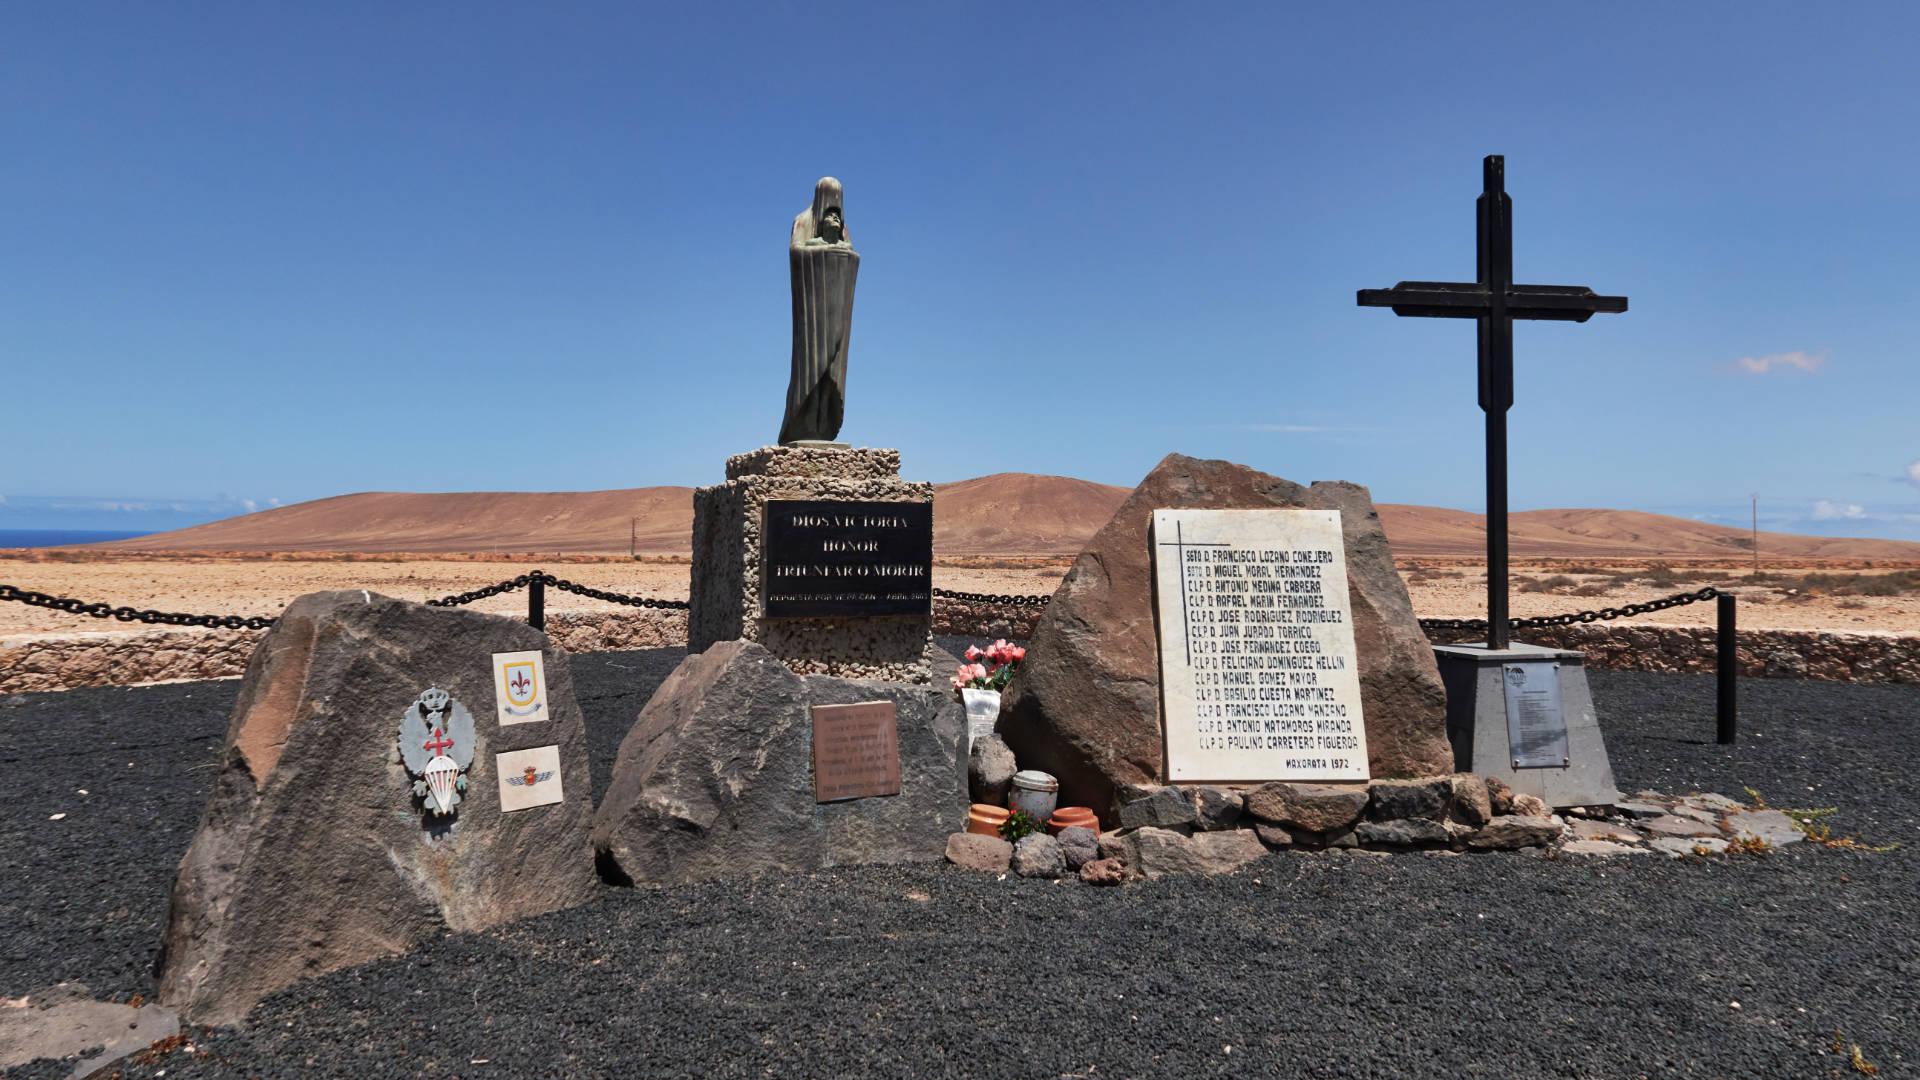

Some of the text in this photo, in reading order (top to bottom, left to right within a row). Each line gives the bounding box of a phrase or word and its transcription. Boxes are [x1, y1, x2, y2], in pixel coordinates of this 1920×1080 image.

[793, 515, 907, 528] DIOS VICTORIA
[823, 540, 879, 552] HONOR
[1212, 550, 1256, 563] FRANCISCO
[1260, 550, 1289, 563] LOZANO
[1292, 550, 1333, 563] CONEJERO
[776, 565, 924, 577] TRIUNFAR O MORIR
[1214, 566, 1242, 578] MIGUEL
[1246, 566, 1271, 578] MORAL
[1275, 566, 1321, 578] HERNANDEZ
[1215, 581, 1248, 593] ANTONIO
[1252, 581, 1281, 593] MEDINA
[1284, 581, 1321, 593] CABRERA
[1216, 595, 1247, 608] RAFAEL
[1250, 595, 1275, 608] MARIN
[1277, 595, 1324, 608] FERNANDEZ
[1218, 611, 1240, 623] JOSE
[1245, 611, 1292, 623] RODRIGUEZ
[1296, 611, 1342, 623] RODRIGUEZ
[1219, 626, 1239, 639] JUAN
[1243, 626, 1274, 639] JURADO
[1277, 626, 1311, 639] TORRICO
[1220, 641, 1241, 654] JOSE
[1244, 641, 1290, 654] FERNANDEZ
[1222, 656, 1264, 670] FELICIANO
[1268, 656, 1313, 670] DOMINGUEZ
[1316, 656, 1344, 670] HELLIN
[1222, 672, 1255, 685] MANUEL
[1259, 672, 1286, 685] GOMEZ
[1290, 672, 1317, 685] MAYOR
[1224, 688, 1256, 702] BASILIO
[1260, 688, 1291, 702] CUESTA
[1294, 688, 1335, 702] MARTINEZ
[1225, 704, 1270, 717] FRANCISCO
[1273, 704, 1305, 717] LOZANO
[1308, 704, 1346, 717] MANZANO
[1227, 720, 1260, 733] ANTONIO
[1264, 720, 1313, 733] MATAMOROS
[1317, 720, 1352, 733] MIRANDA
[1228, 736, 1263, 750] PAULINO
[1267, 736, 1314, 750] CARRETERO
[1317, 736, 1358, 750] FIGUEROA
[1286, 759, 1349, 769] MAXORATA 1972
